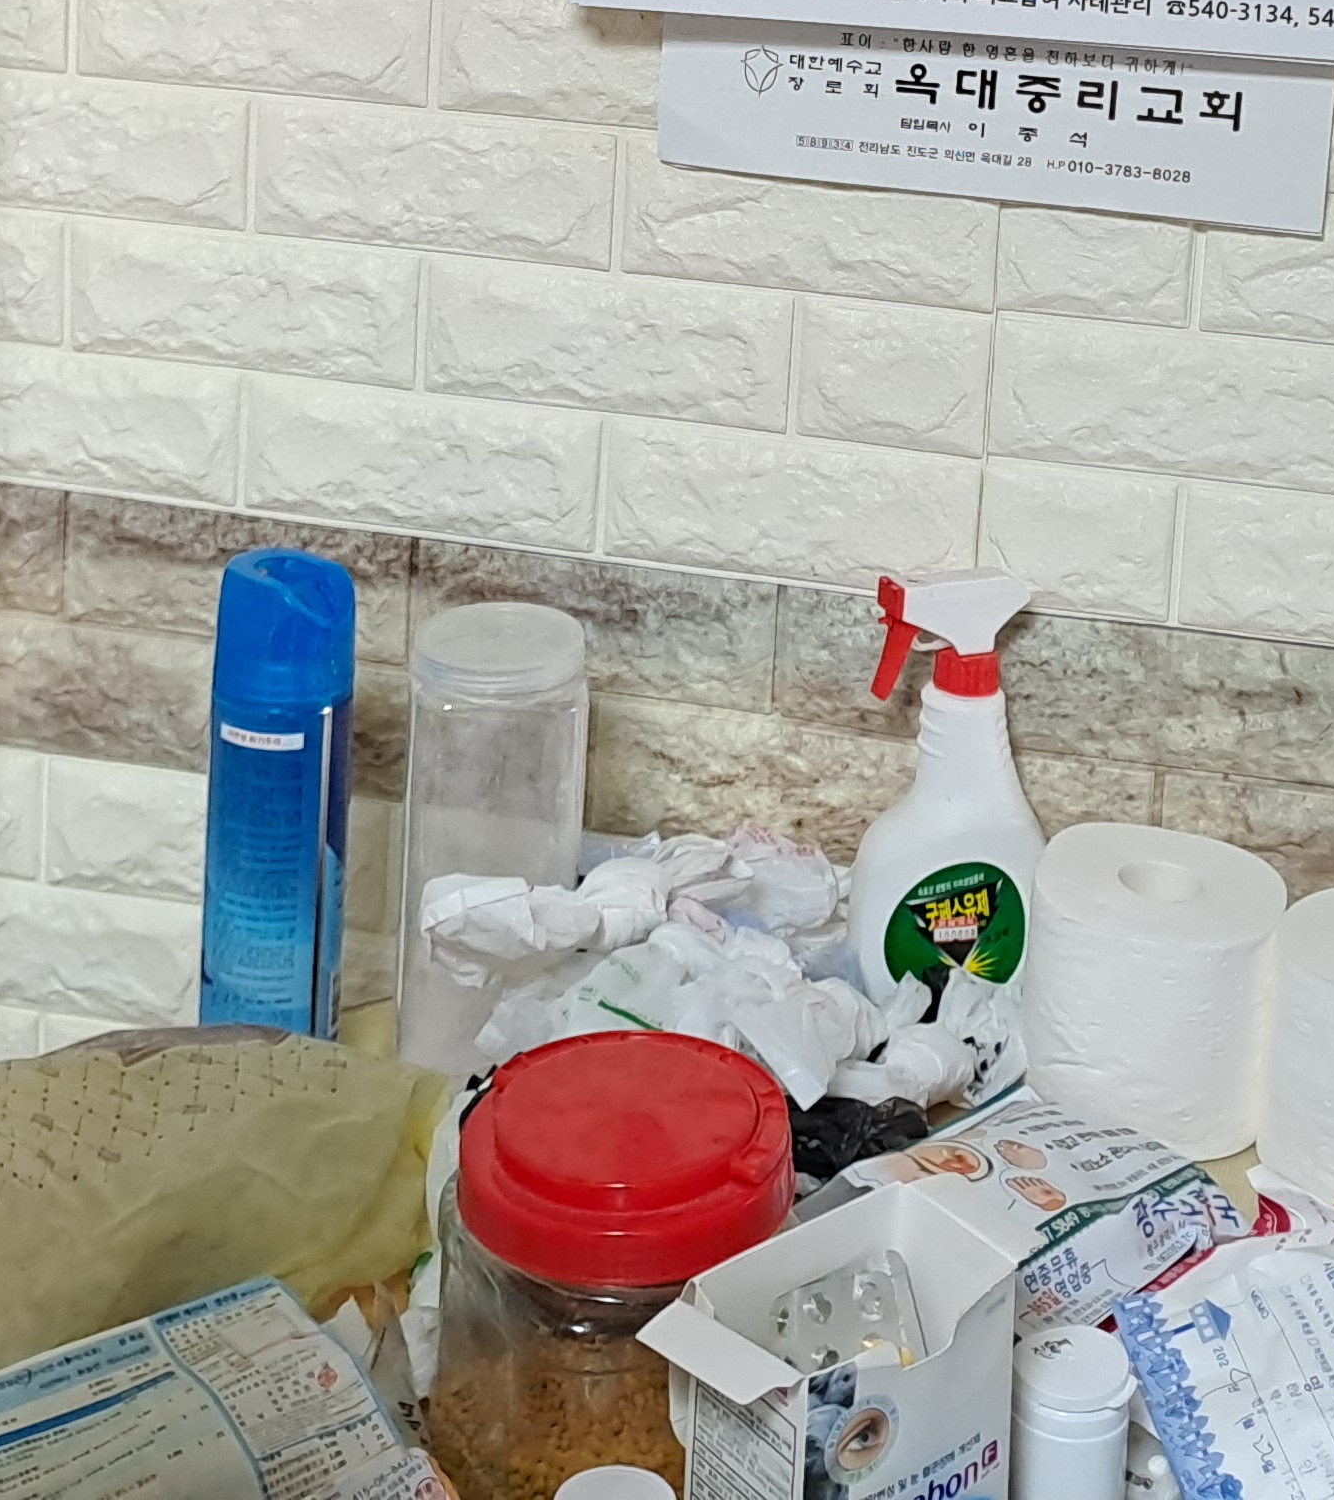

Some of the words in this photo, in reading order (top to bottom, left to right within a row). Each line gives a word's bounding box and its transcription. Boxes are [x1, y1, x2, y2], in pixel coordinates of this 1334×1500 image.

[788, 53, 883, 76] 대한예수교
[858, 140, 902, 156] 전라남도
[906, 145, 939, 160] 진도군
[943, 148, 976, 163] 의신면
[1017, 156, 1032, 168] 28
[1068, 160, 1191, 184] 010-3783-8028
[1024, 1246, 1079, 1295] 연중무휴
[1055, 1261, 1091, 1299] 영업중
[1212, 1345, 1230, 1369] 202
